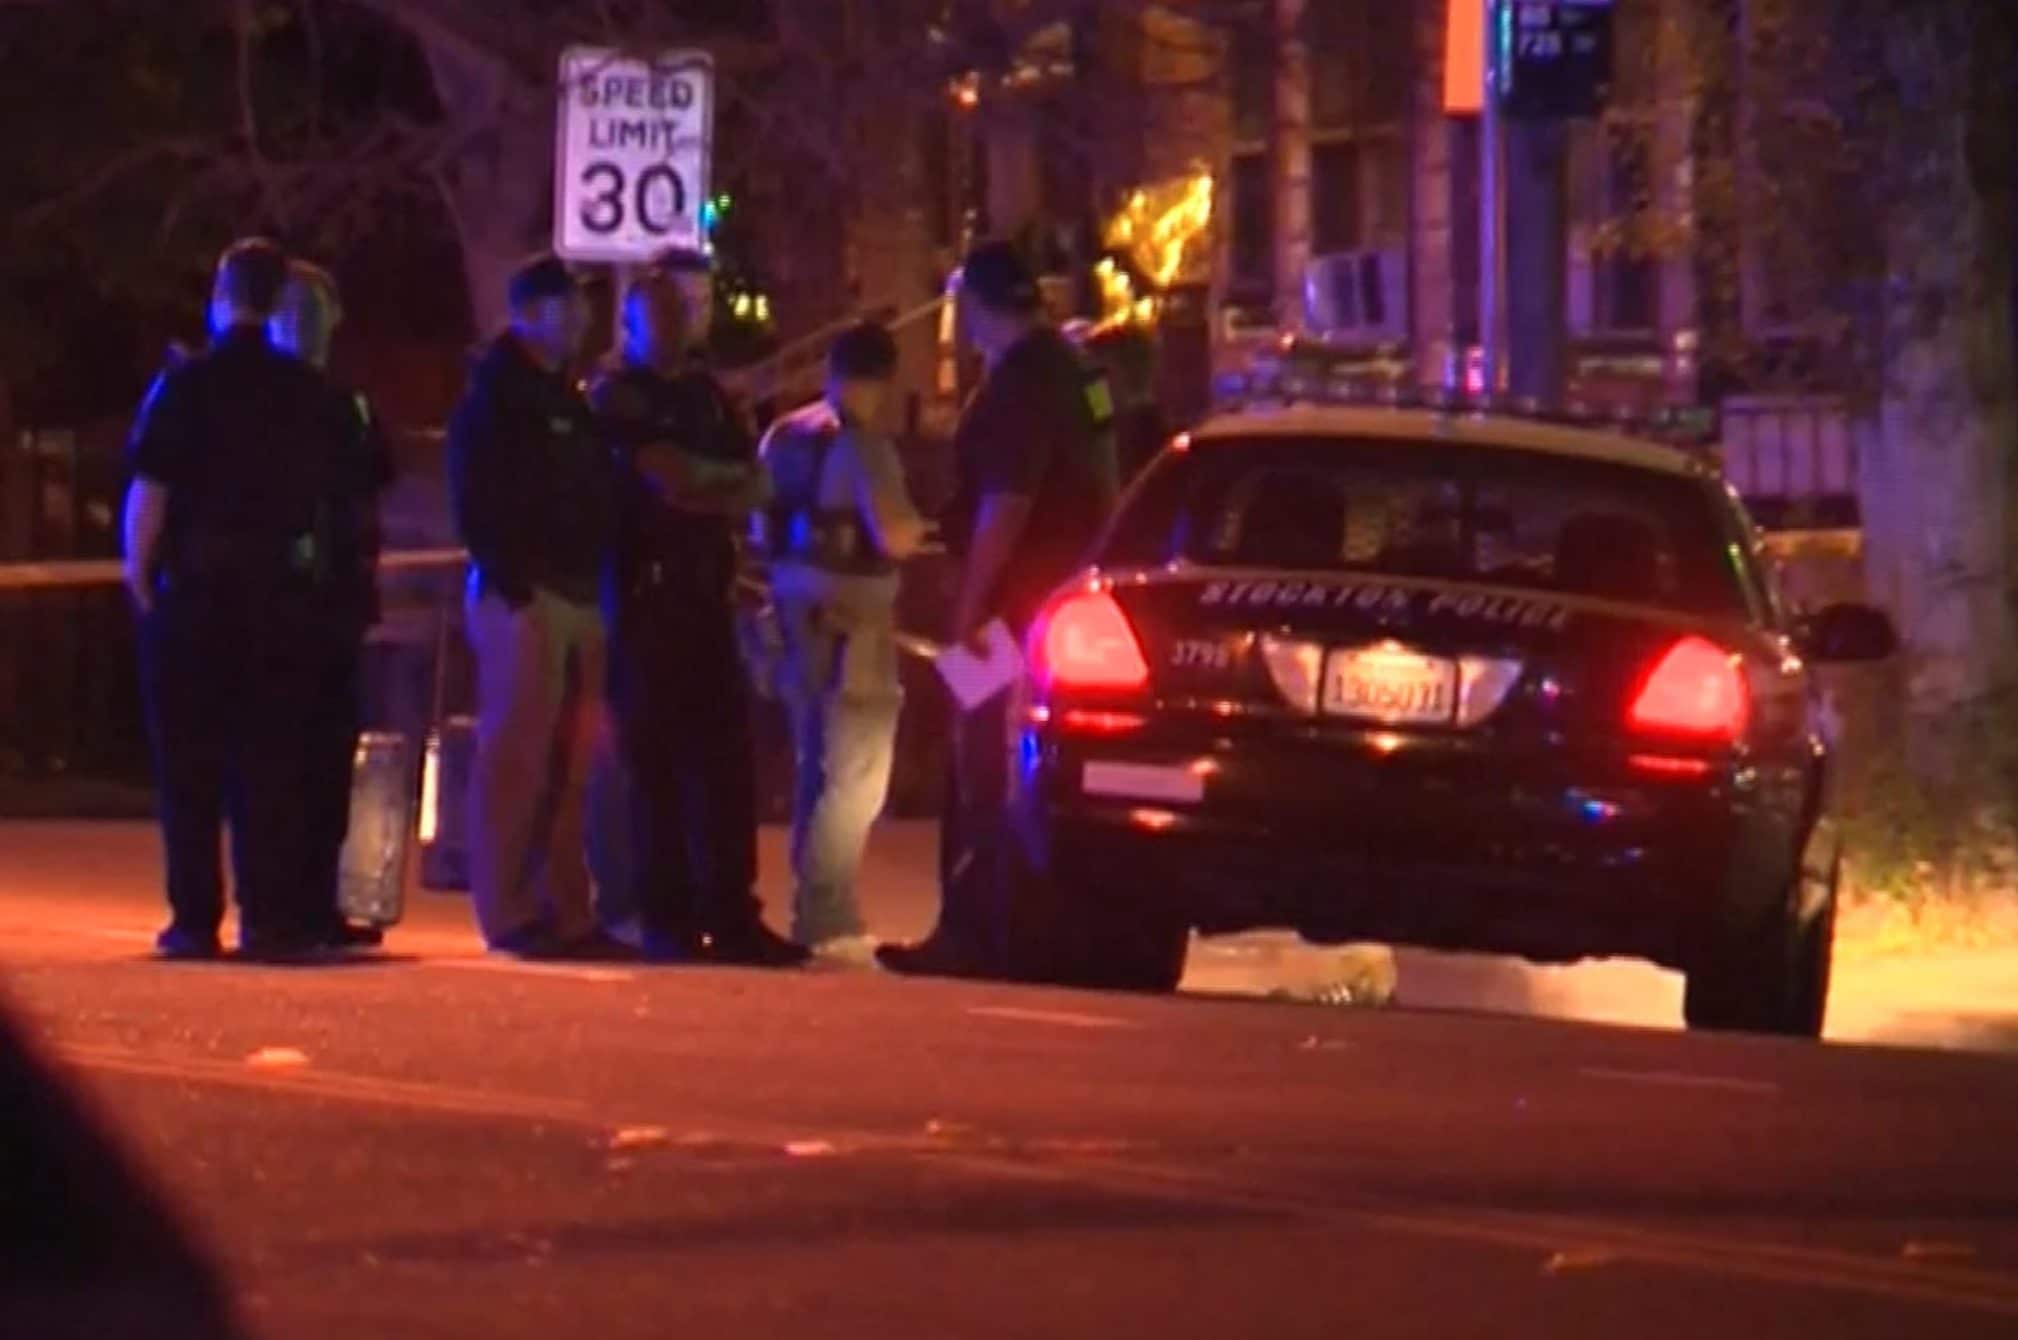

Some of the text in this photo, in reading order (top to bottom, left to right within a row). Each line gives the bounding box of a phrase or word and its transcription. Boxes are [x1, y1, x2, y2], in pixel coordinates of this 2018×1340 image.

[578, 73, 694, 110] SPEED
[589, 118, 677, 151] LIMIT
[580, 161, 686, 236] 30
[1200, 580, 1568, 632] STOCKTON POLICE
